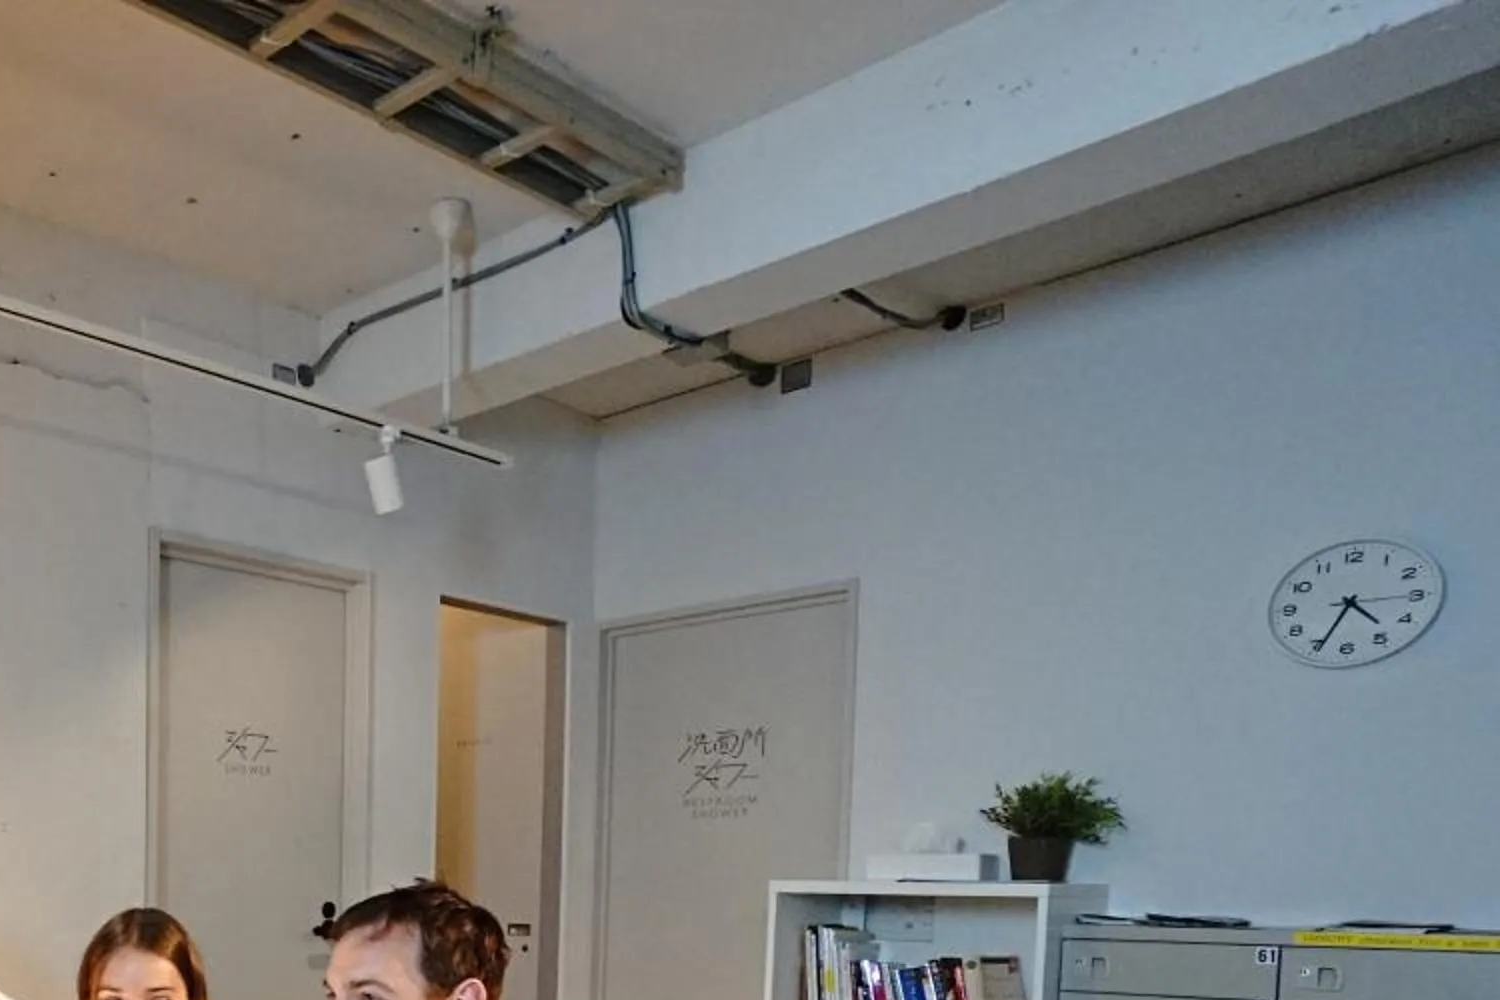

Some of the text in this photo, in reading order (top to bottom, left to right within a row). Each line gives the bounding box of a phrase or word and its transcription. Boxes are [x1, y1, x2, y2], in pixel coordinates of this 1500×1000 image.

[1344, 551, 1364, 564] 12
[1317, 561, 1331, 574] 11
[1401, 567, 1417, 580] 2
[1293, 581, 1312, 593] 10
[1409, 589, 1425, 602] 3
[1283, 604, 1297, 617] 9
[1397, 612, 1412, 624] 4
[1289, 624, 1303, 637] 8
[1372, 632, 1388, 645] 5
[1339, 642, 1355, 655] 6
[1258, 949, 1275, 963] 61
